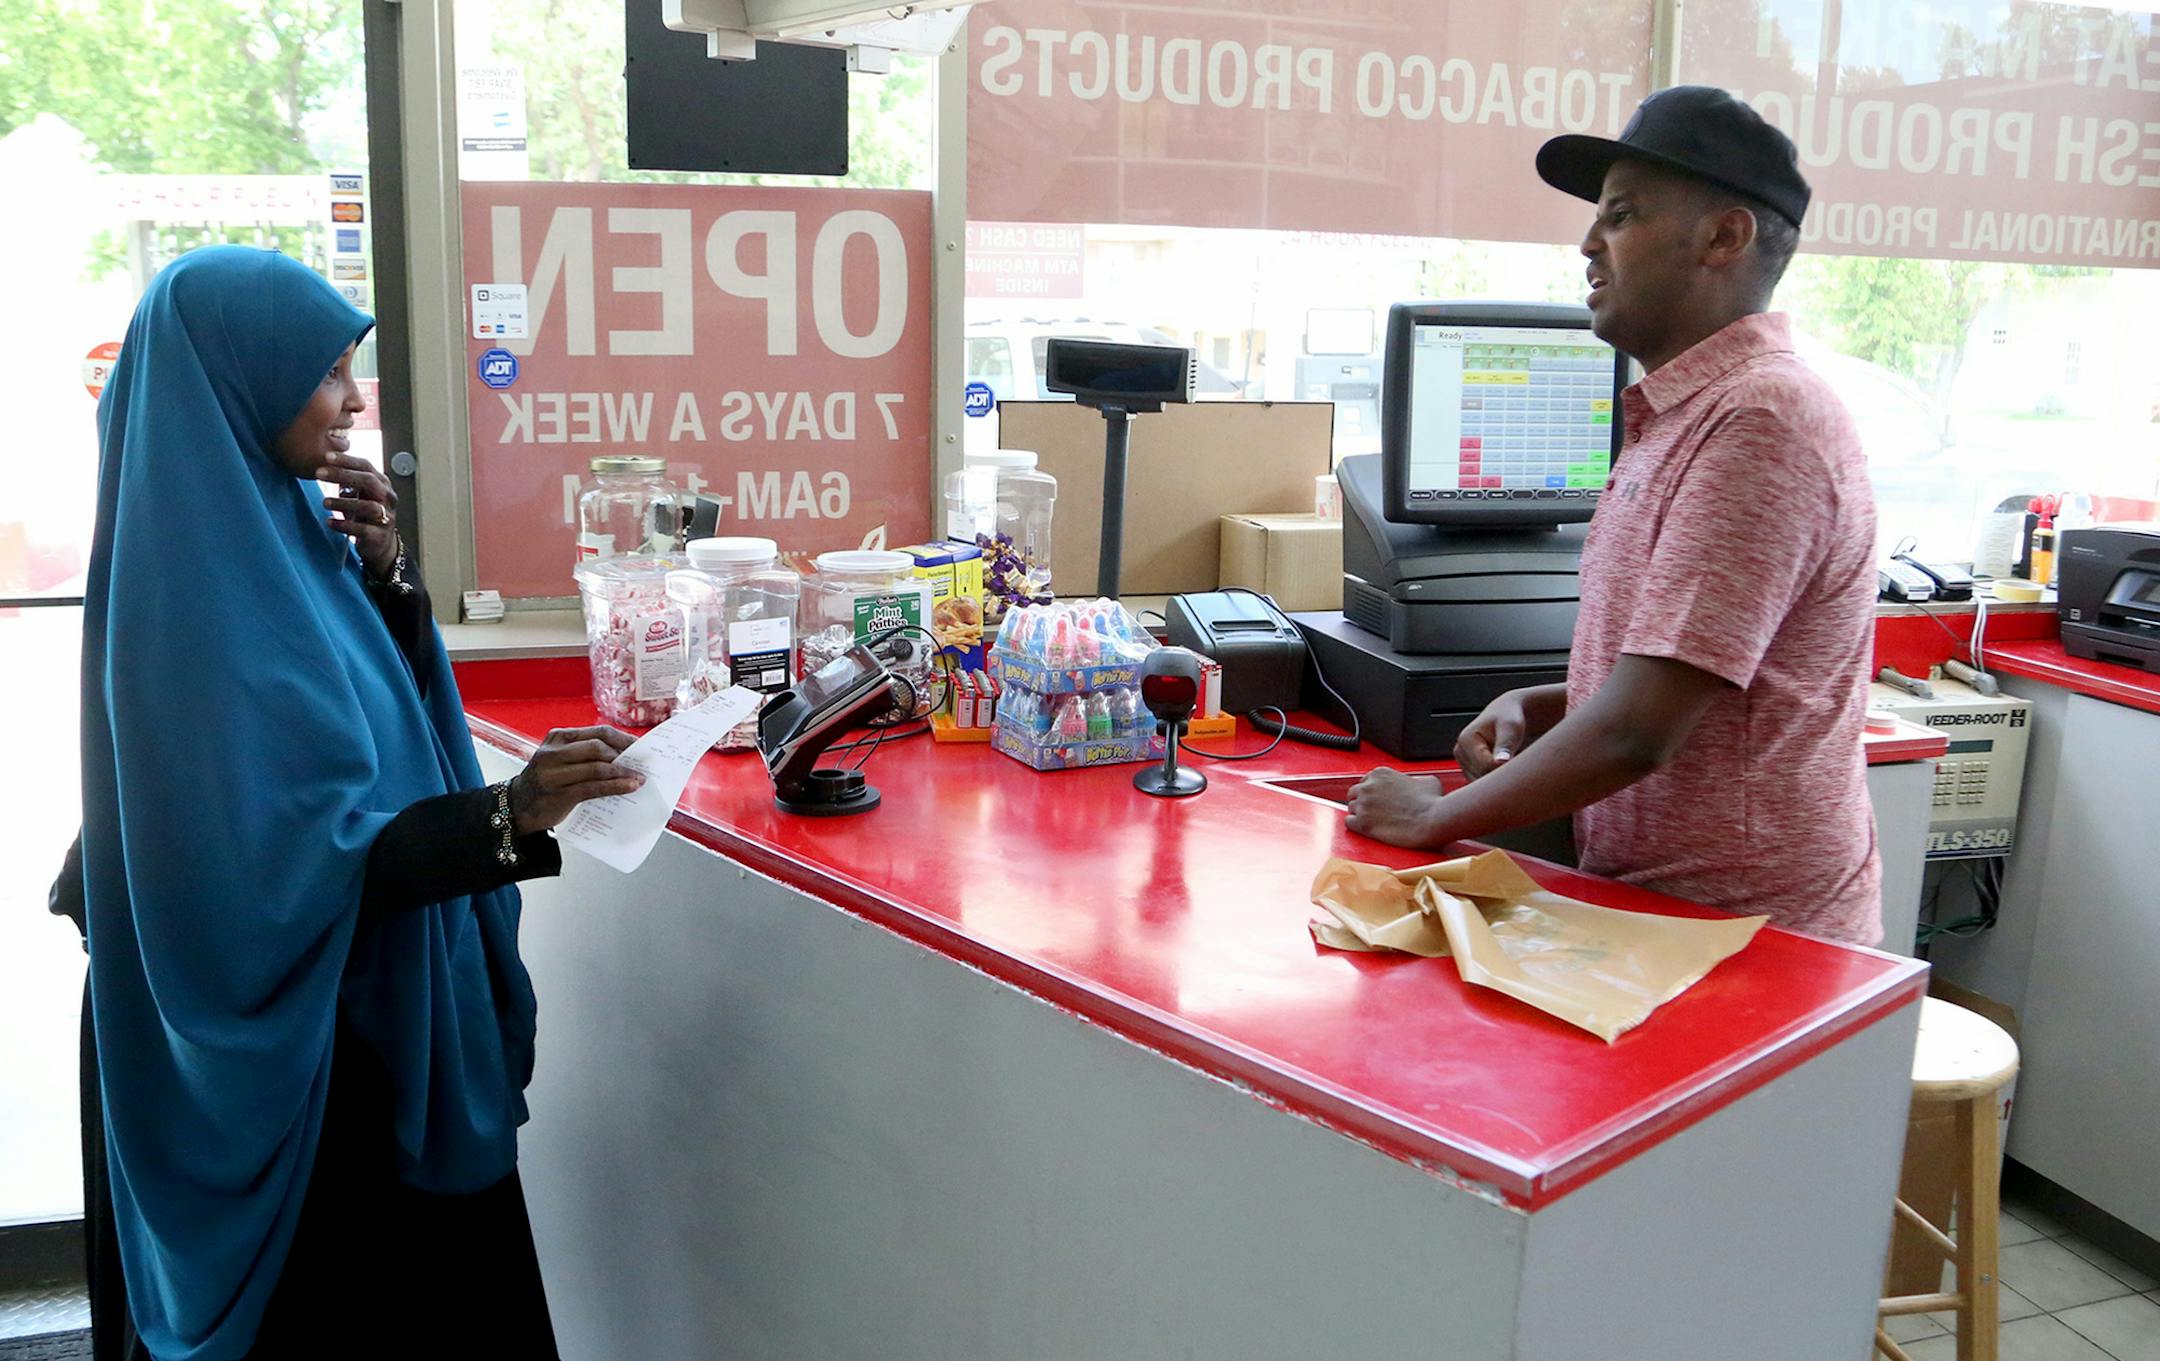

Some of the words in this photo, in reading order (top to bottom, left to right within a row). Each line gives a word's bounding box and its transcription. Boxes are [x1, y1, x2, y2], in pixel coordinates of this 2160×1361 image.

[334, 180, 360, 190] VISA
[491, 292, 521, 301] Square
[1438, 331, 1462, 341] Ready
[485, 360, 513, 375] ADT
[966, 393, 988, 407] ADT
[874, 607, 902, 619] Mint
[867, 617, 908, 633] Patties
[1926, 712, 2008, 727] VEEDER-ROOT
[1926, 828, 2010, 851] TLS-350
